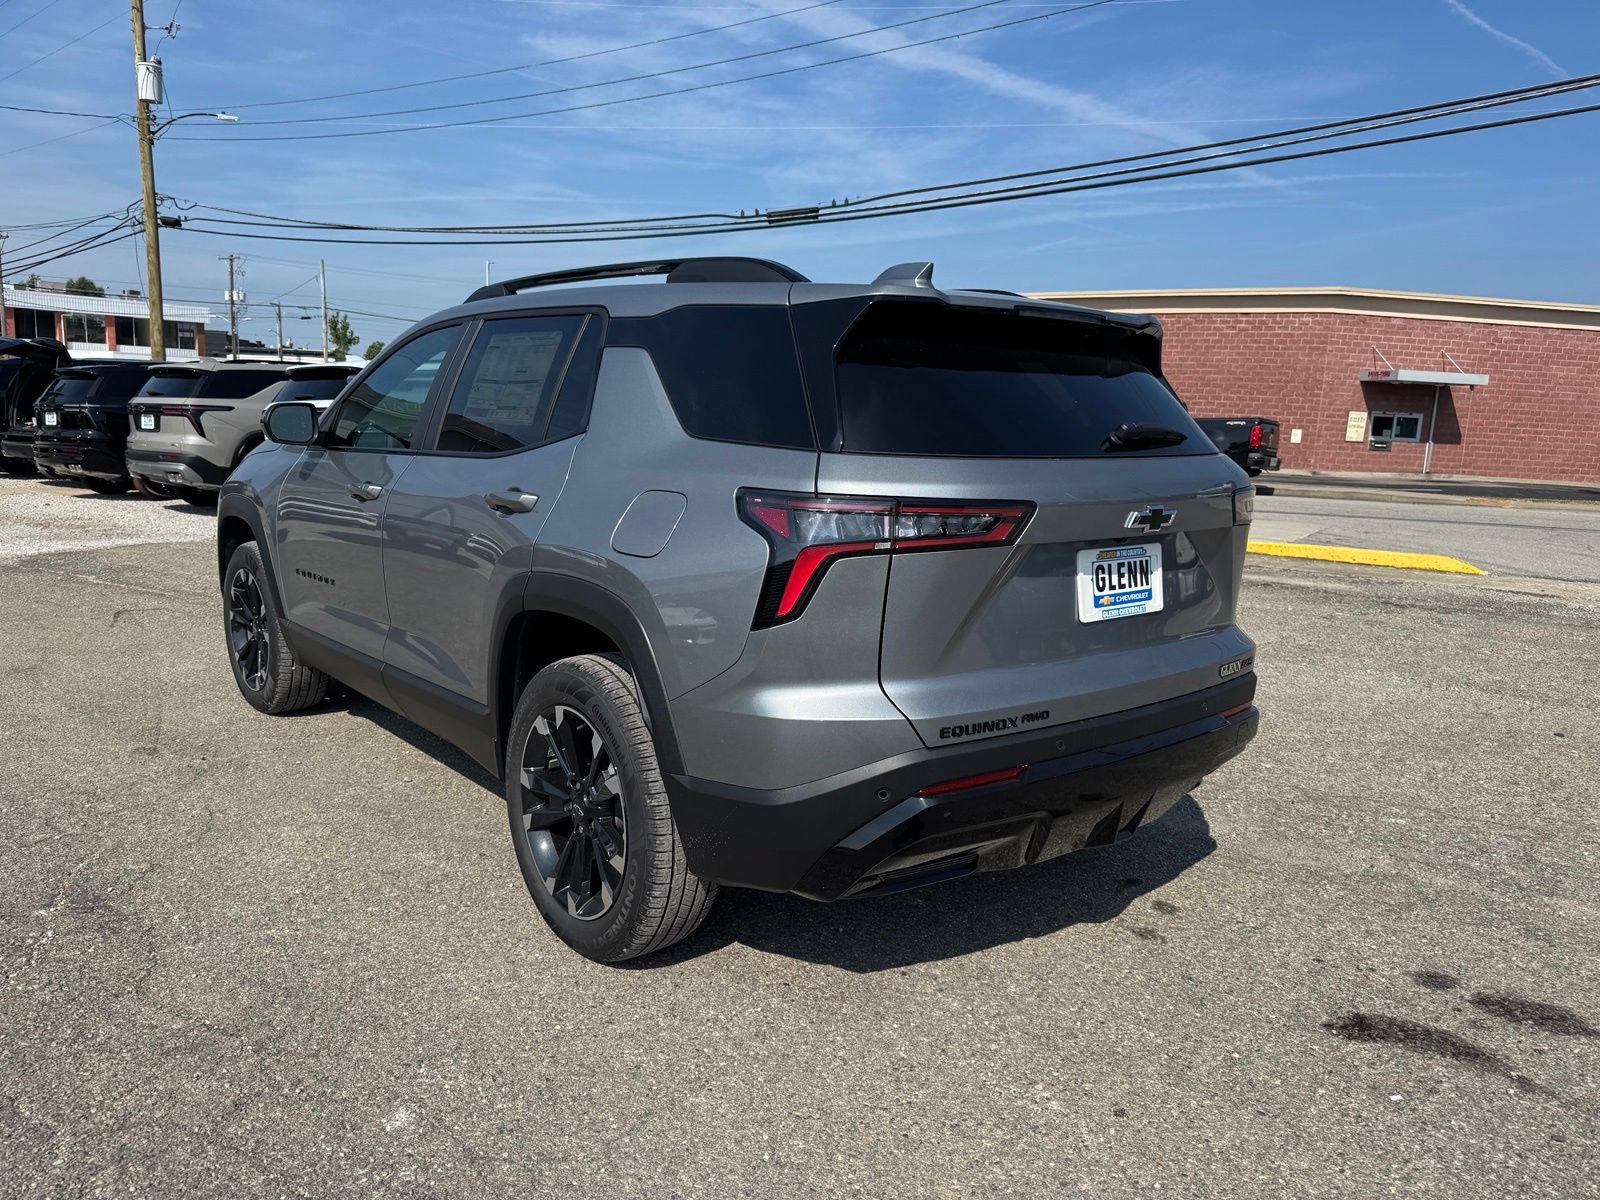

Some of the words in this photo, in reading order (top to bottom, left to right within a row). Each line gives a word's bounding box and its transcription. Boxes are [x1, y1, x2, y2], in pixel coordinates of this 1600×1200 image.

[1094, 559, 1150, 592] GLENN
[1116, 592, 1149, 602] CHEVROLET
[1103, 609, 1119, 618] GLENN
[1119, 605, 1146, 616] CHEVROLET
[939, 716, 1018, 739] EQUINOX
[1021, 710, 1050, 724] AWD
